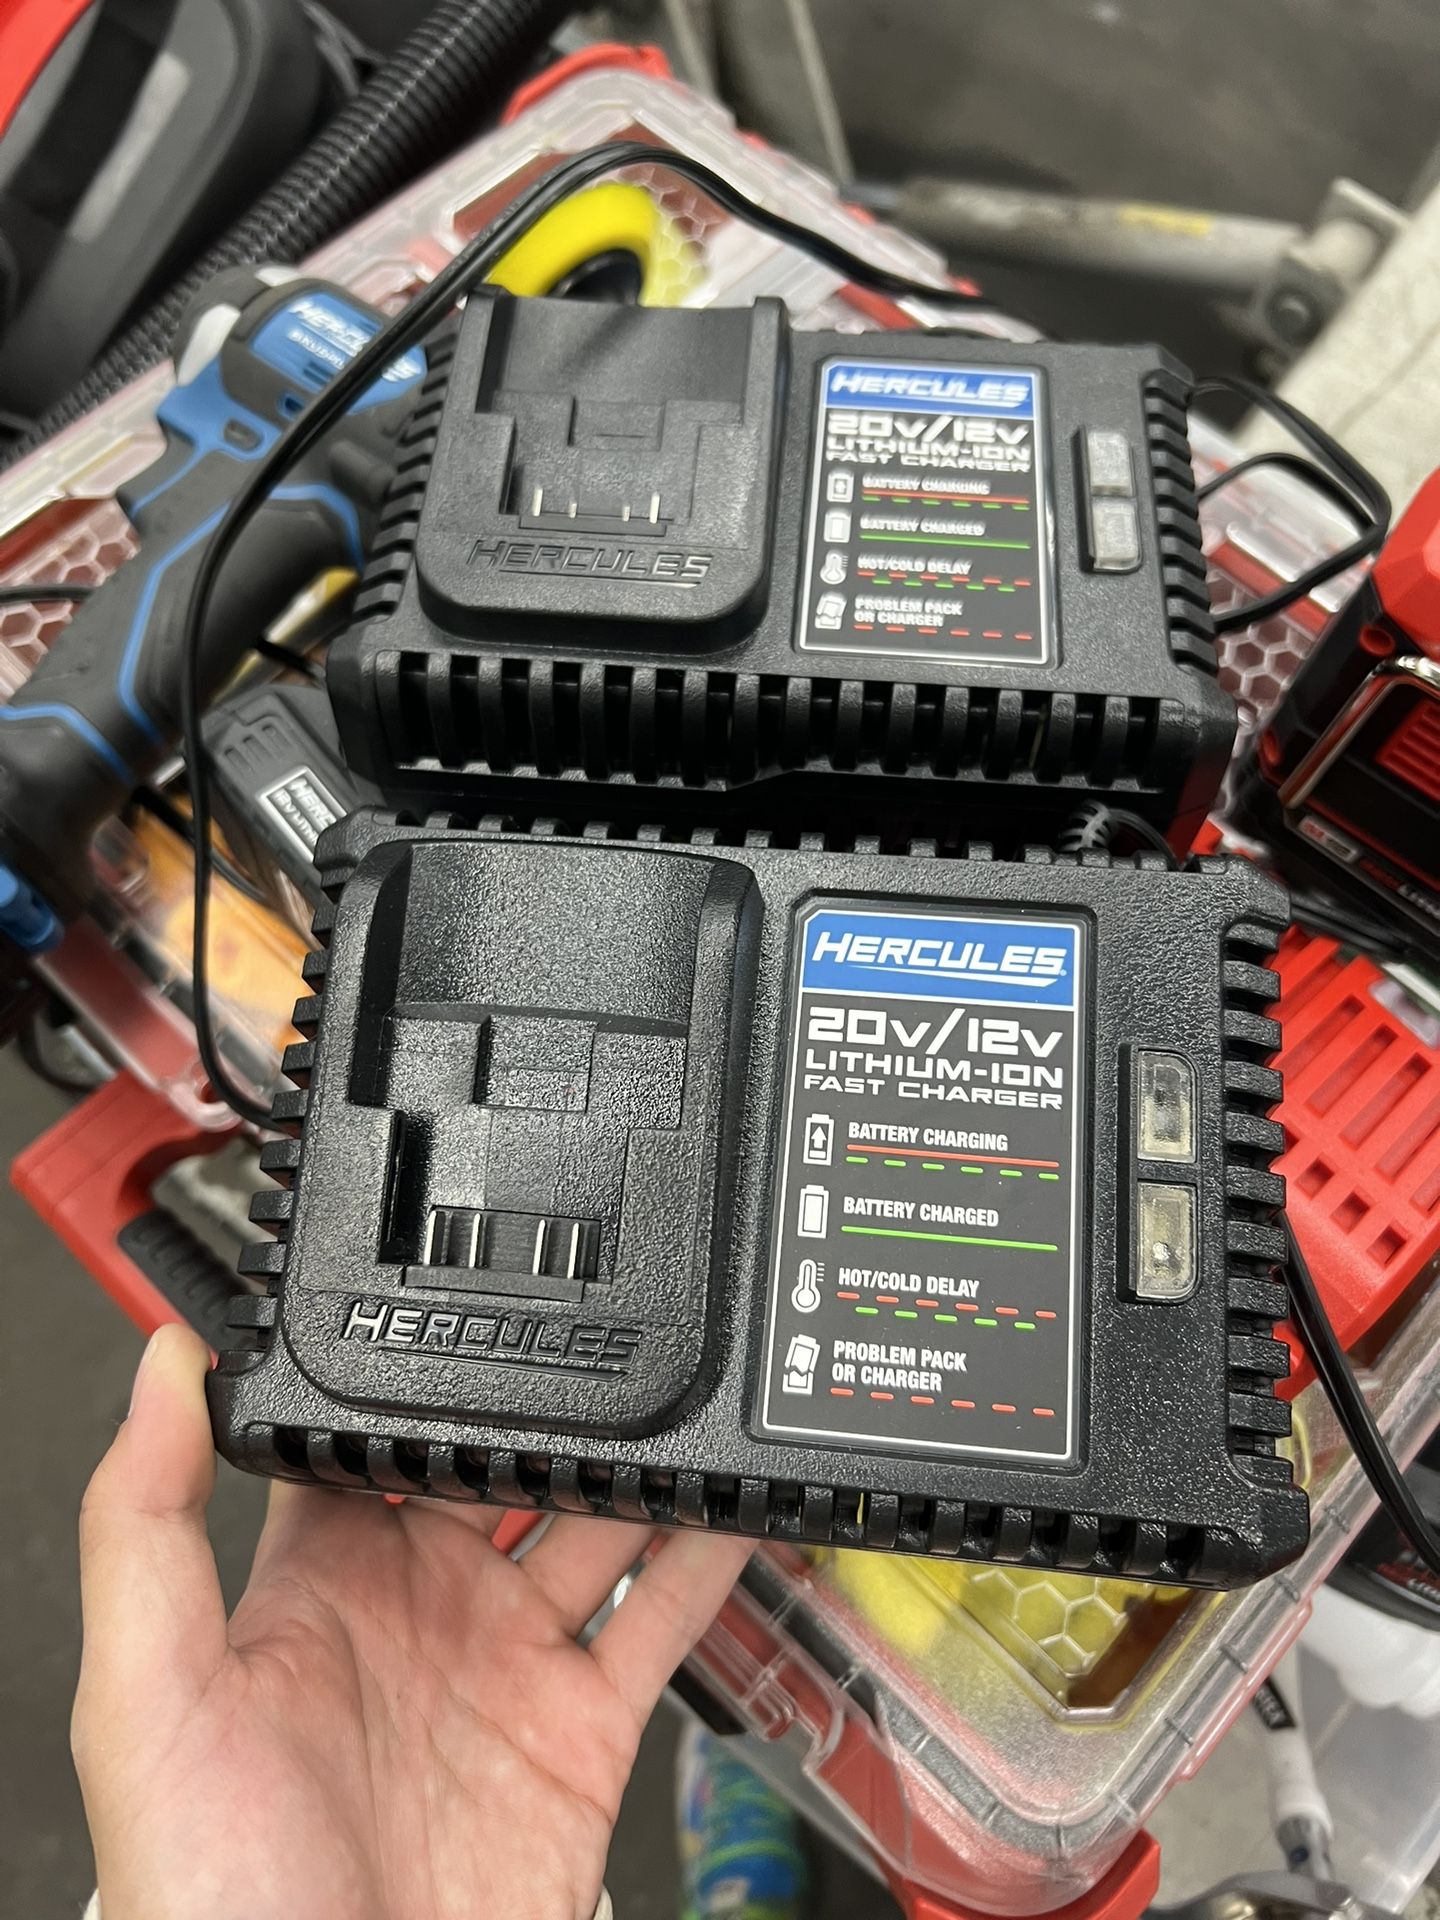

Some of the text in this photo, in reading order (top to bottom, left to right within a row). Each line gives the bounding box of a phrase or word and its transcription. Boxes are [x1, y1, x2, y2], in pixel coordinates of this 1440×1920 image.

[831, 371, 1030, 401] HERCULES
[826, 436, 1031, 461] LITHIUM-ION
[826, 451, 1031, 472] FAST CHARGER
[862, 473, 991, 495] BATTERY CHARGING
[860, 513, 986, 536] BATTERY CHARGED
[466, 539, 713, 578] HERCULES
[857, 553, 973, 575] HOT/COLD DELAY
[854, 594, 965, 616] PROBLEM PACK
[854, 610, 945, 627] OR CHARGER
[290, 777, 337, 832] HERC
[812, 931, 1067, 976] HERCULES
[805, 1049, 1063, 1089] LITHIUM-ION
[804, 1074, 1063, 1110] FAST CHARGER
[848, 1122, 1008, 1151] BATTERY CHARGING
[843, 1196, 999, 1227] BATTERY CHARGED
[838, 1267, 980, 1298] HOT/COLD DELAY
[341, 1302, 643, 1365] HERCULES
[833, 1340, 968, 1372] PROBLEM PACK
[832, 1363, 943, 1392] OR CHARGER
